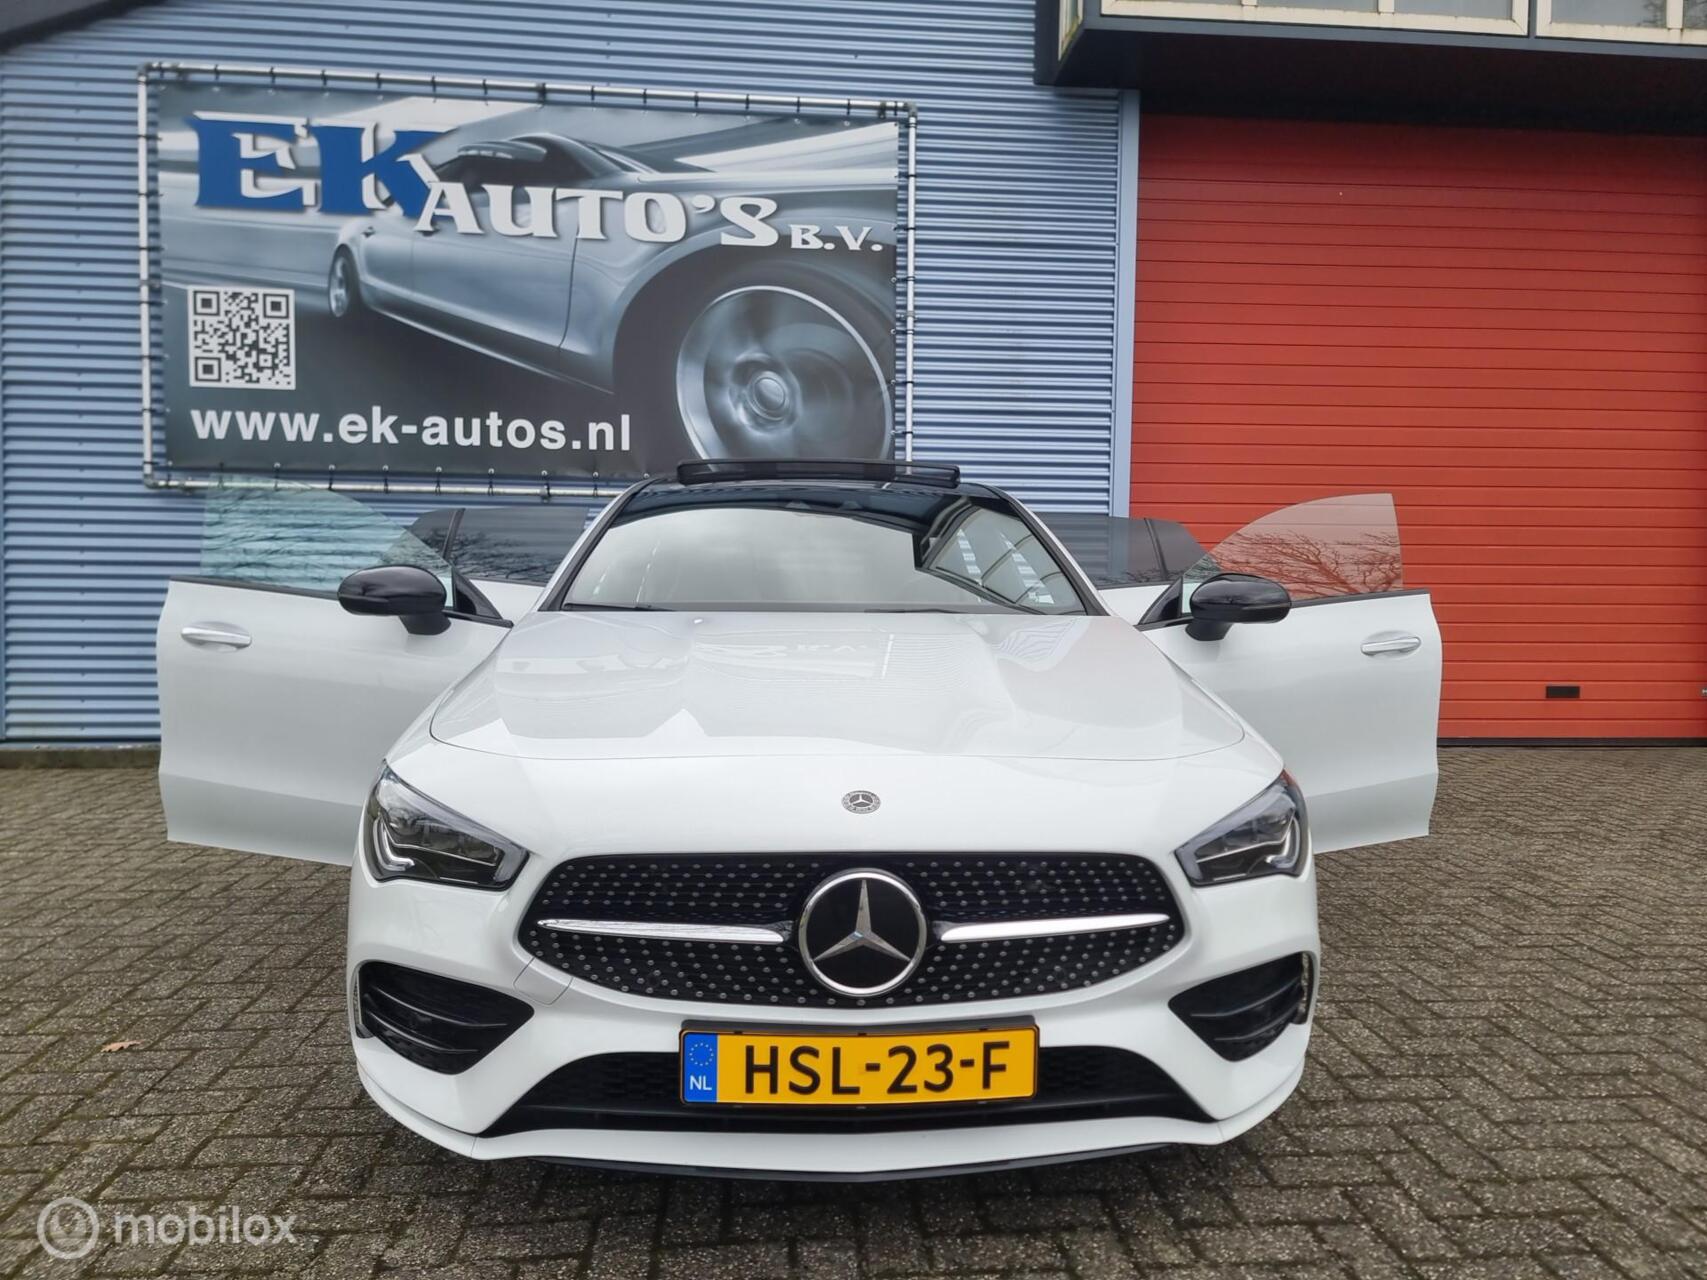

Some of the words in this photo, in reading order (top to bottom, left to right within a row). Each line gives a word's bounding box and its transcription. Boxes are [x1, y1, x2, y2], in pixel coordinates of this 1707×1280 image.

[184, 111, 457, 220] EK
[789, 224, 884, 252] B.V.
[190, 406, 632, 452] www.ek-autos.nl
[689, 1075, 713, 1092] NL
[744, 1040, 1011, 1095] HSL-23-F
